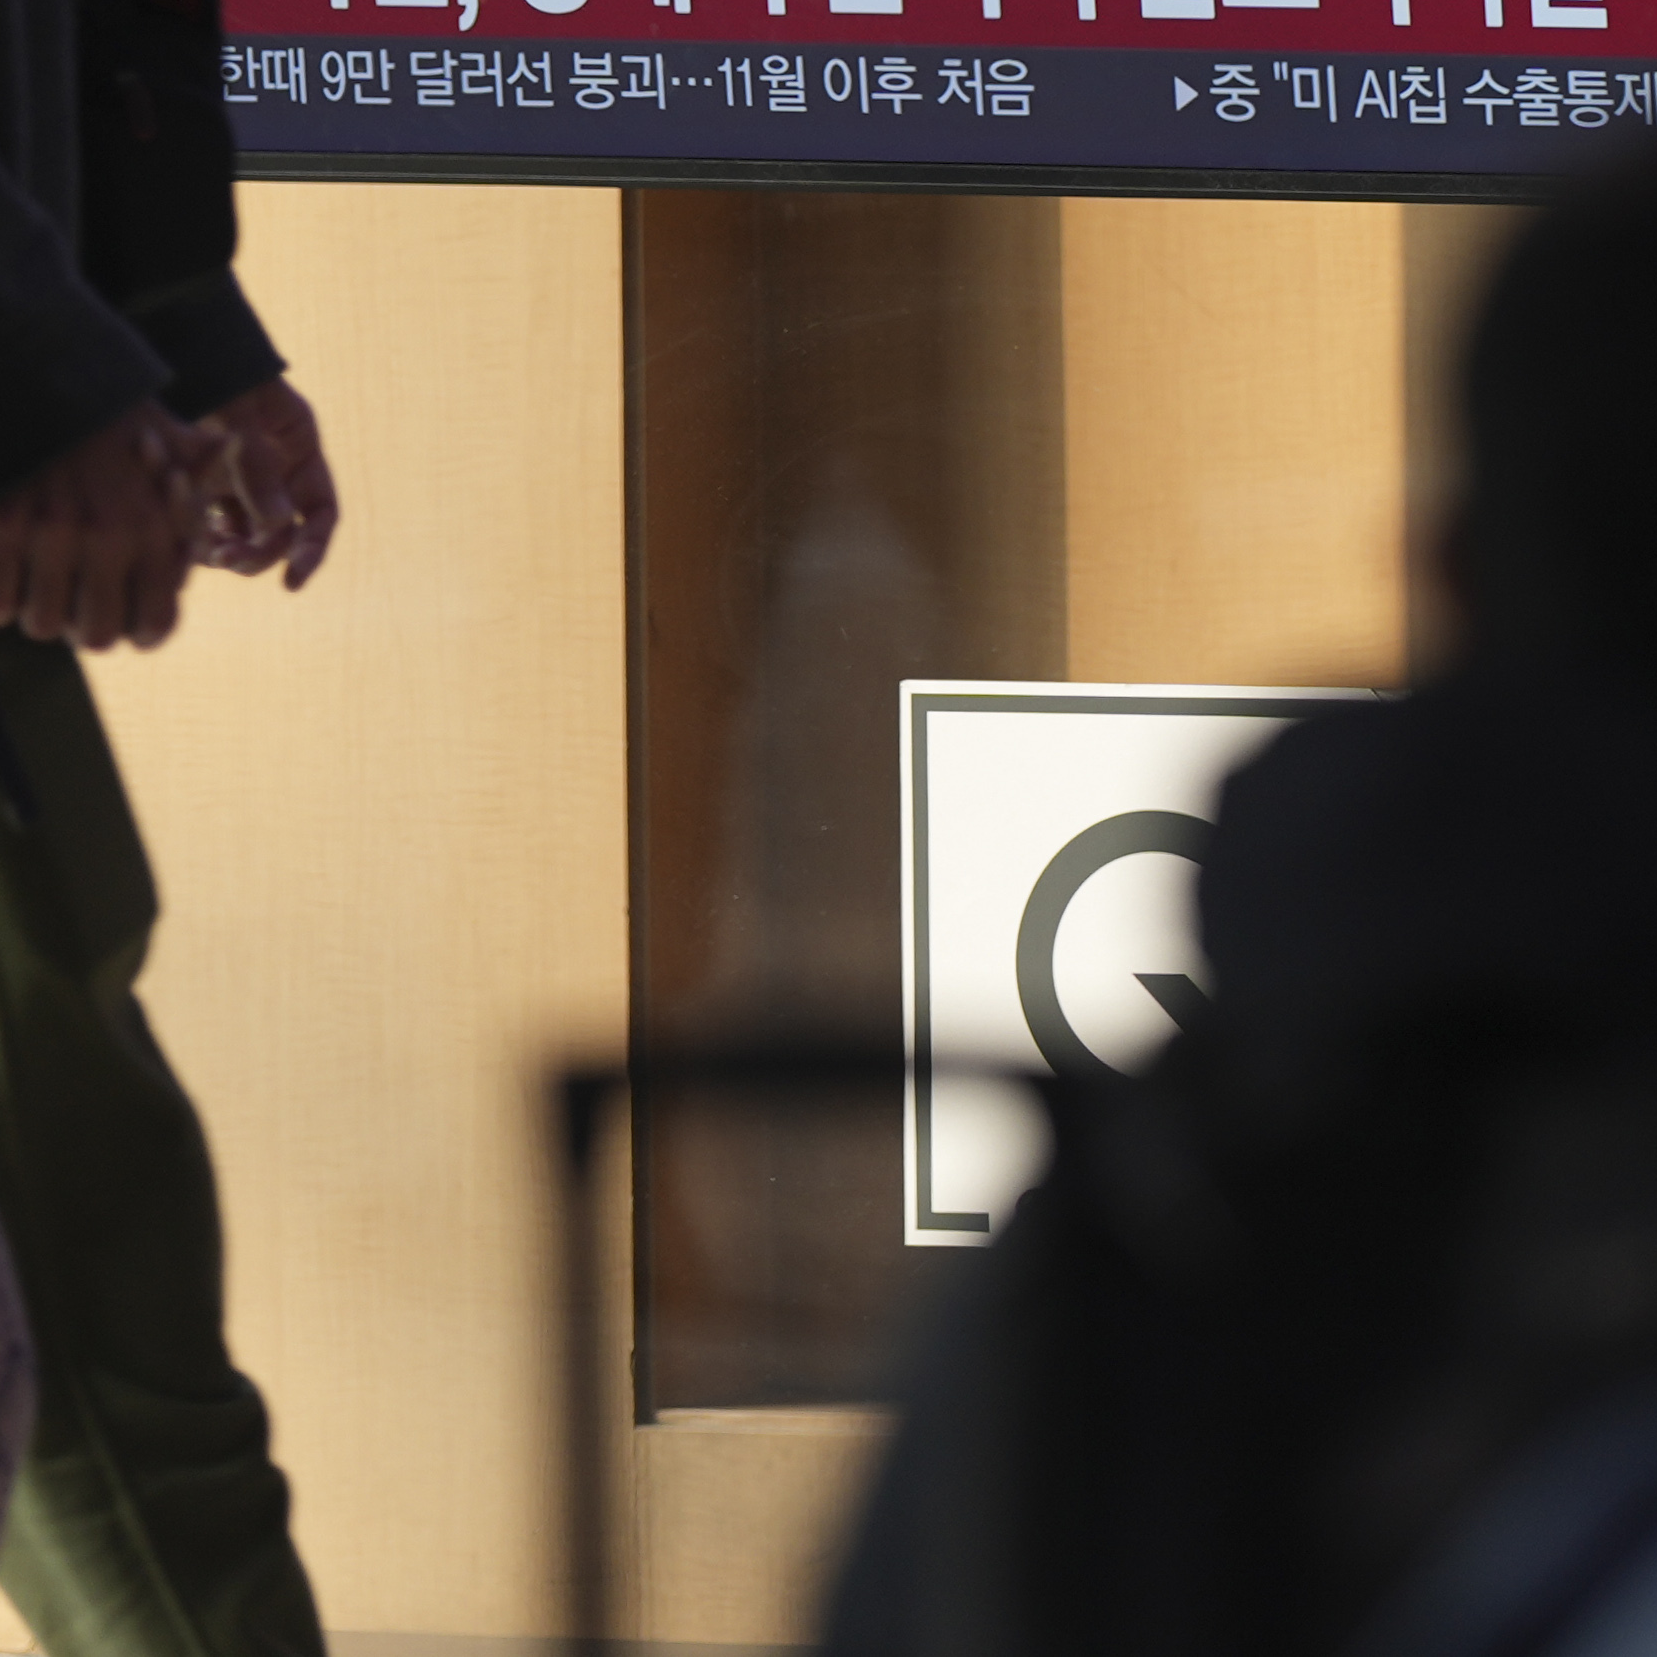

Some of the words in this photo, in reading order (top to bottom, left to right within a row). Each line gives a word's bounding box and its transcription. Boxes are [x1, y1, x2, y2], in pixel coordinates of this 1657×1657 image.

[220, 45, 309, 105] 한때
[320, 48, 396, 106] 9만
[409, 50, 556, 108] 달러선
[823, 55, 923, 116] 이후
[936, 58, 1036, 118] 처음
[1208, 63, 1261, 124] 중
[1272, 60, 1338, 124] "미
[1354, 66, 1448, 125] AI칩
